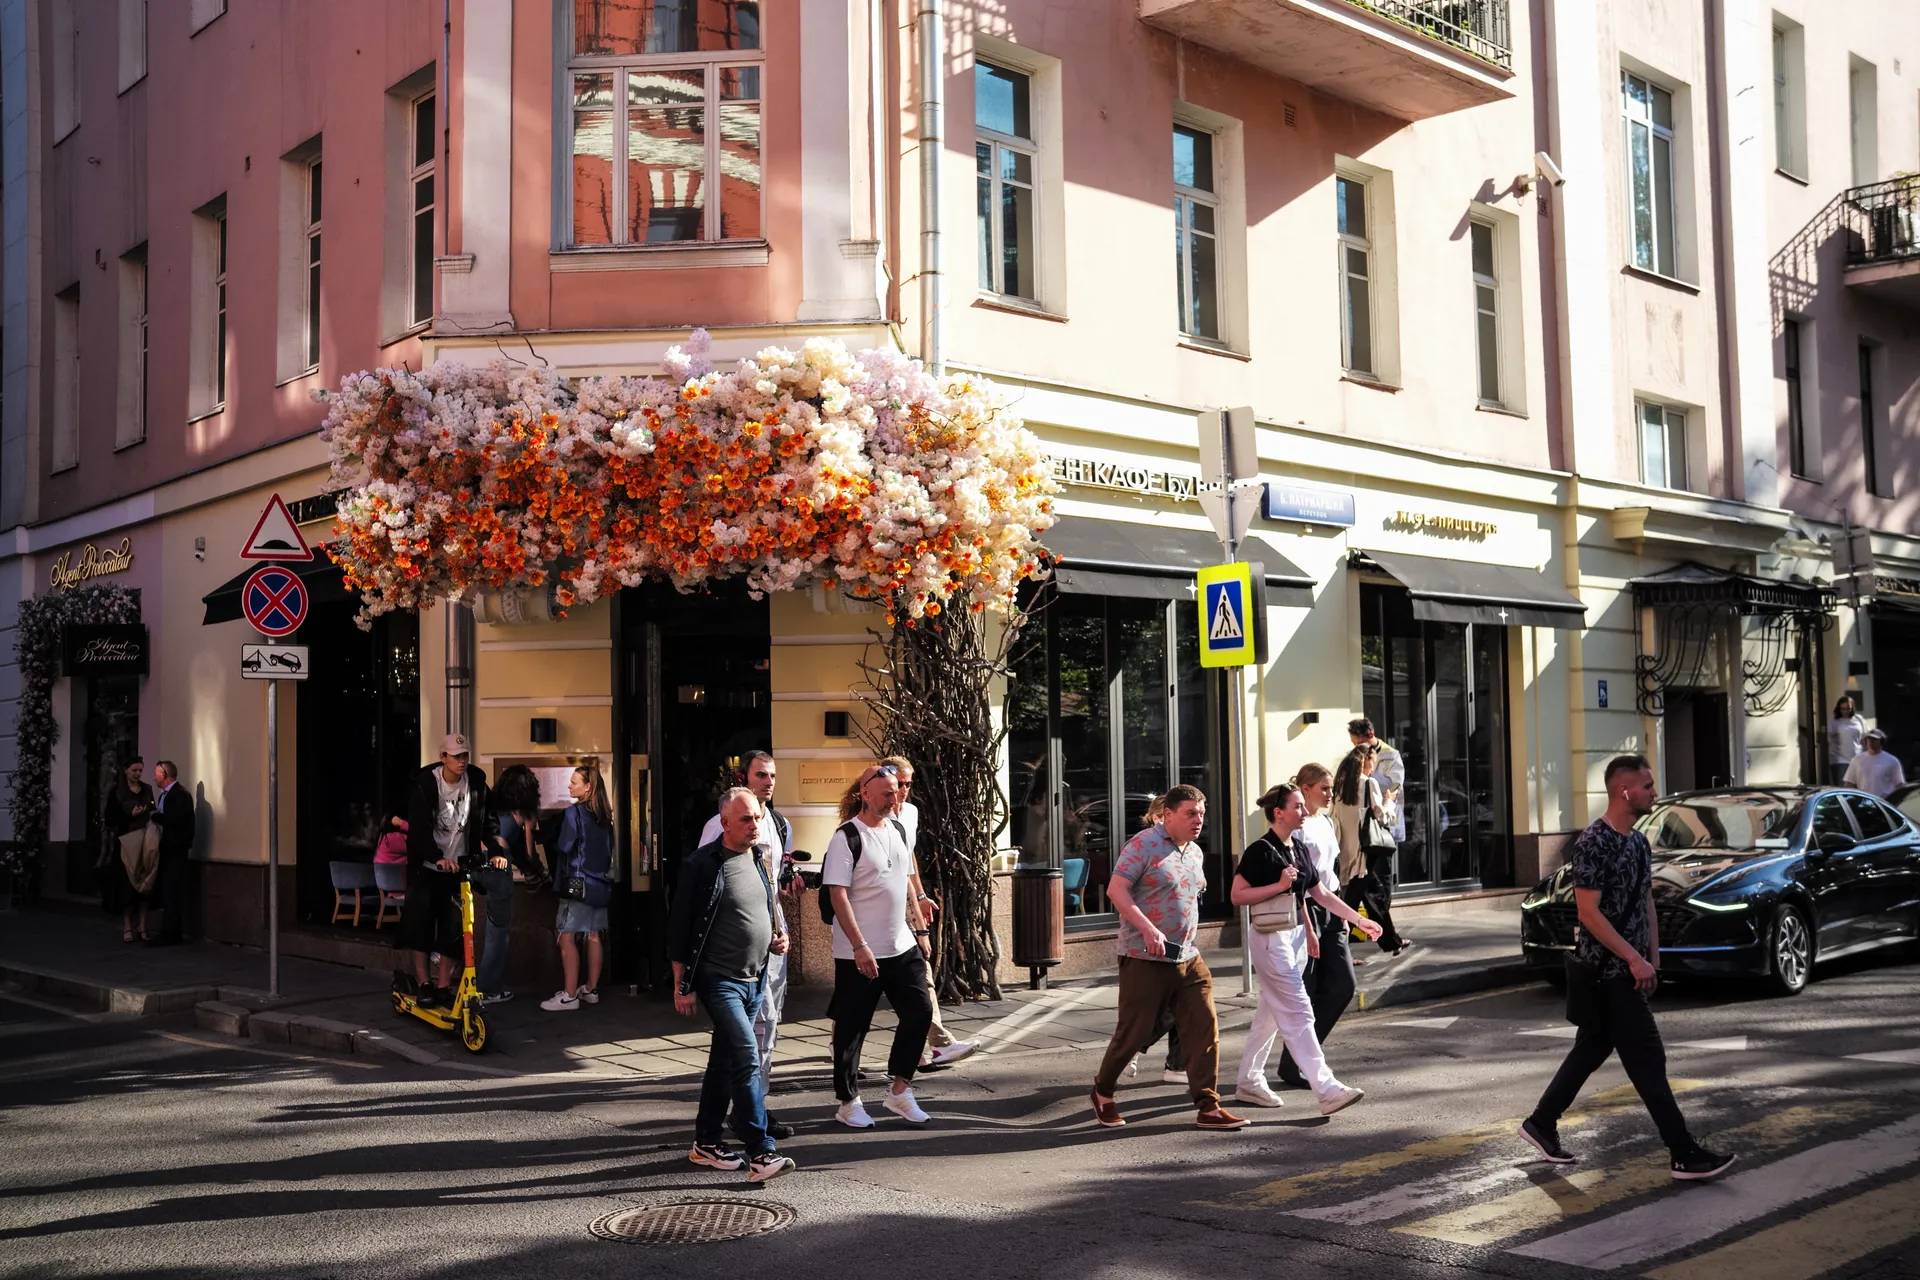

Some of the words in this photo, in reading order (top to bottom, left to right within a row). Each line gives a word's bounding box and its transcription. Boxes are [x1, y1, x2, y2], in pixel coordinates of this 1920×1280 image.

[1093, 461, 1163, 492] КАФЕ
[1168, 473, 1193, 501] by
[51, 551, 83, 594] Agent
[81, 537, 133, 581] Provocateur
[76, 644, 140, 663] Provocateur
[87, 636, 129, 653] Agent
